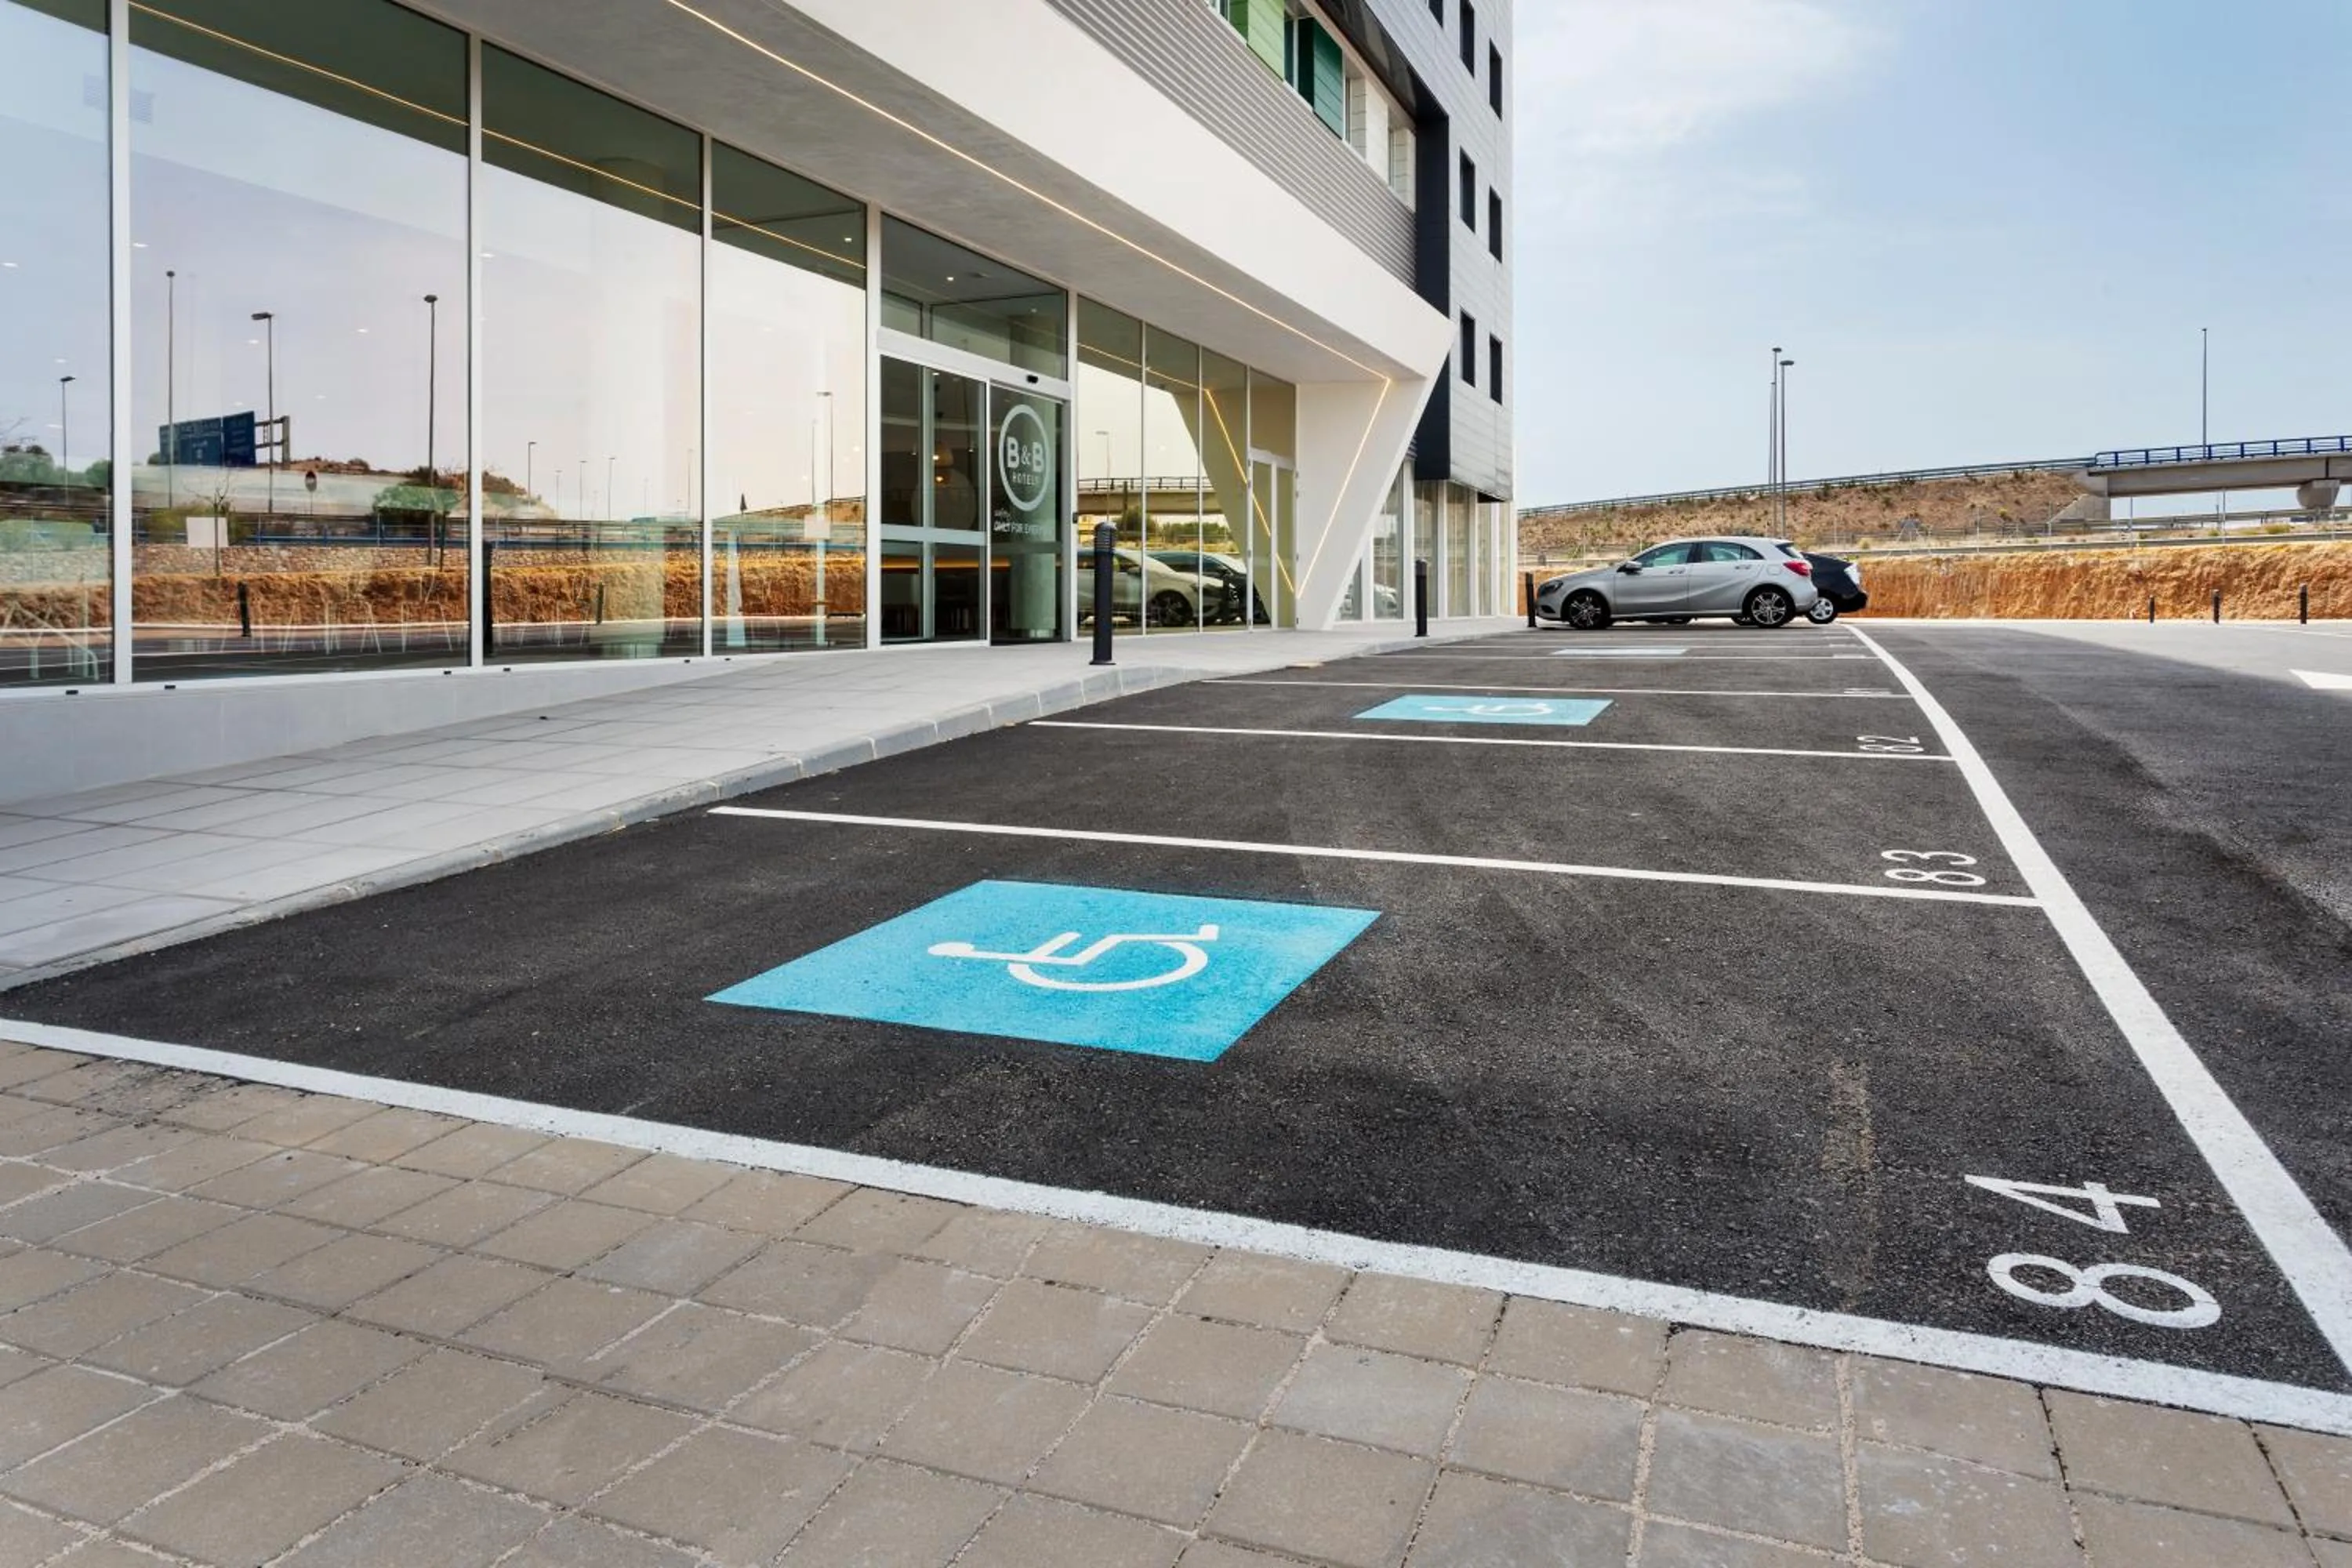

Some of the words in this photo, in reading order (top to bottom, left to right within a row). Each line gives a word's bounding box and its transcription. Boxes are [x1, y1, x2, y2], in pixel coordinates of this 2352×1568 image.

[1007, 436, 1044, 473] B&B
[1857, 735, 1924, 753] 82
[1882, 850, 1986, 886] 83
[1965, 1174, 2222, 1328] 84
